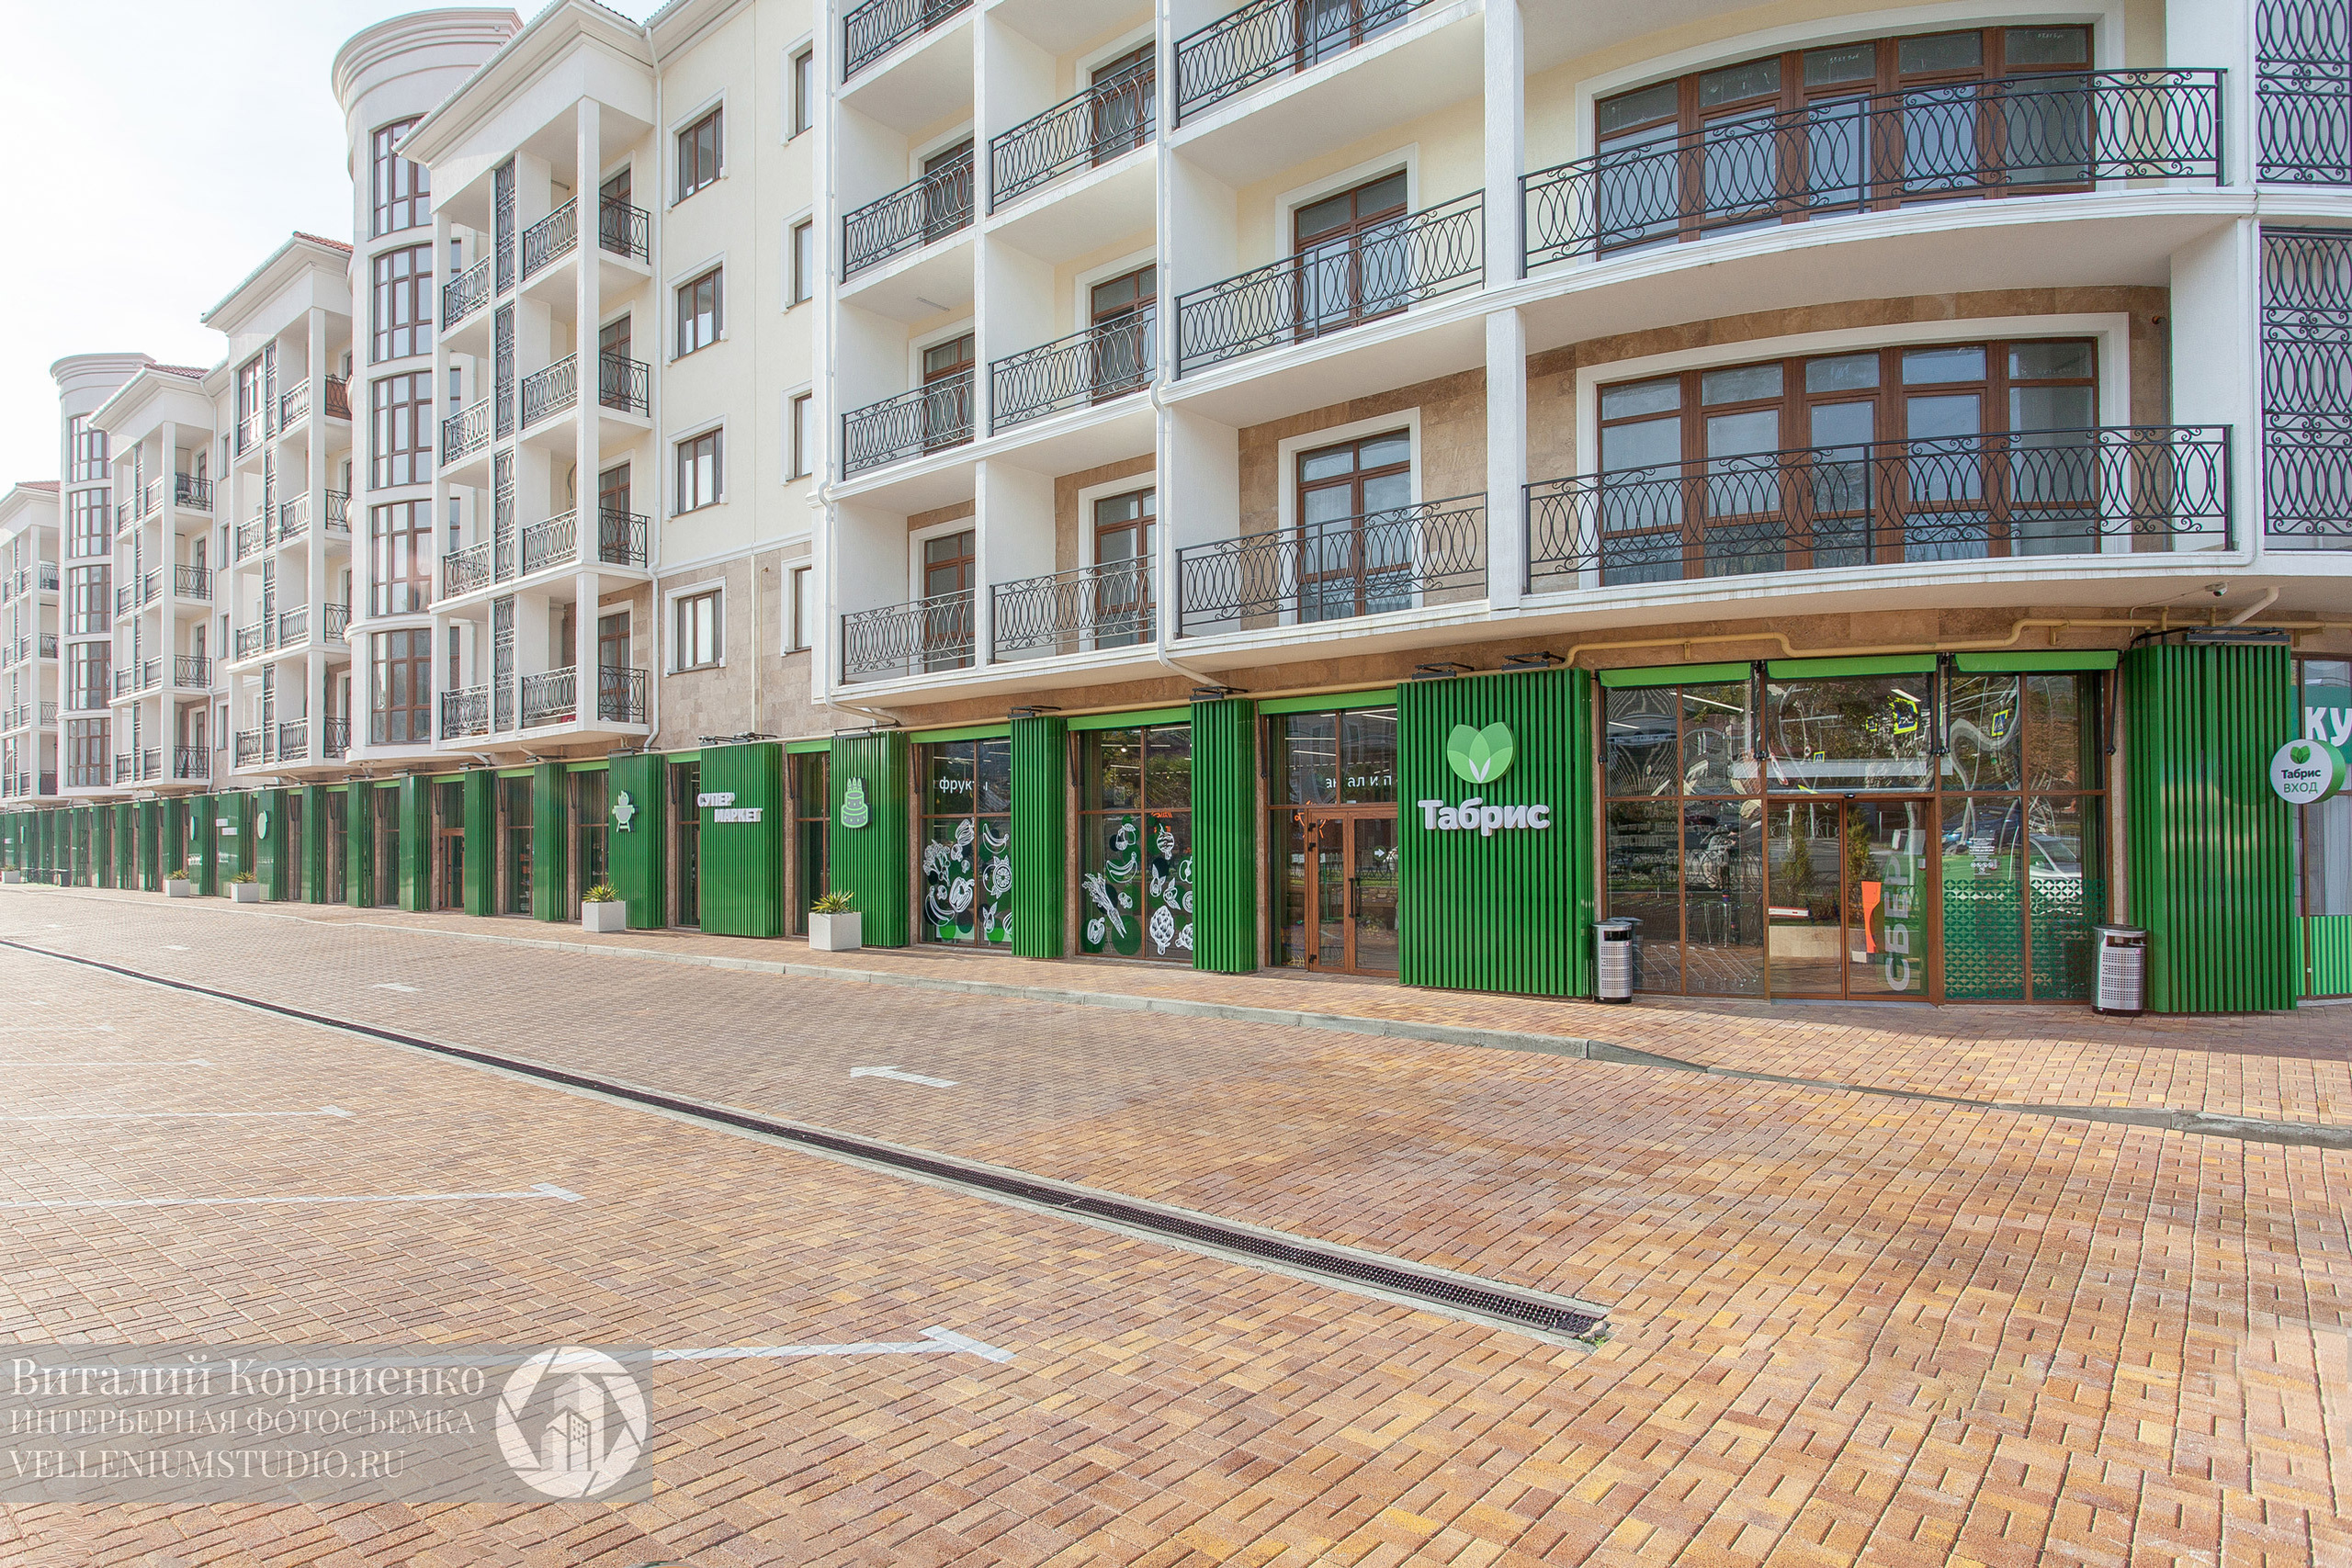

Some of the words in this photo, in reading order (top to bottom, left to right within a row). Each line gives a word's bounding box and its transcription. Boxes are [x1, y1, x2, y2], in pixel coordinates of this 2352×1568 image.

[2280, 768, 2322, 781] Табрис
[939, 776, 989, 794] фрукы
[2283, 782, 2318, 794] ВХОД
[697, 793, 735, 807] СУПЕР
[714, 808, 763, 823] МАРКЕТ
[1418, 797, 1551, 837] Табрис
[1884, 856, 1911, 991] СБЕР
